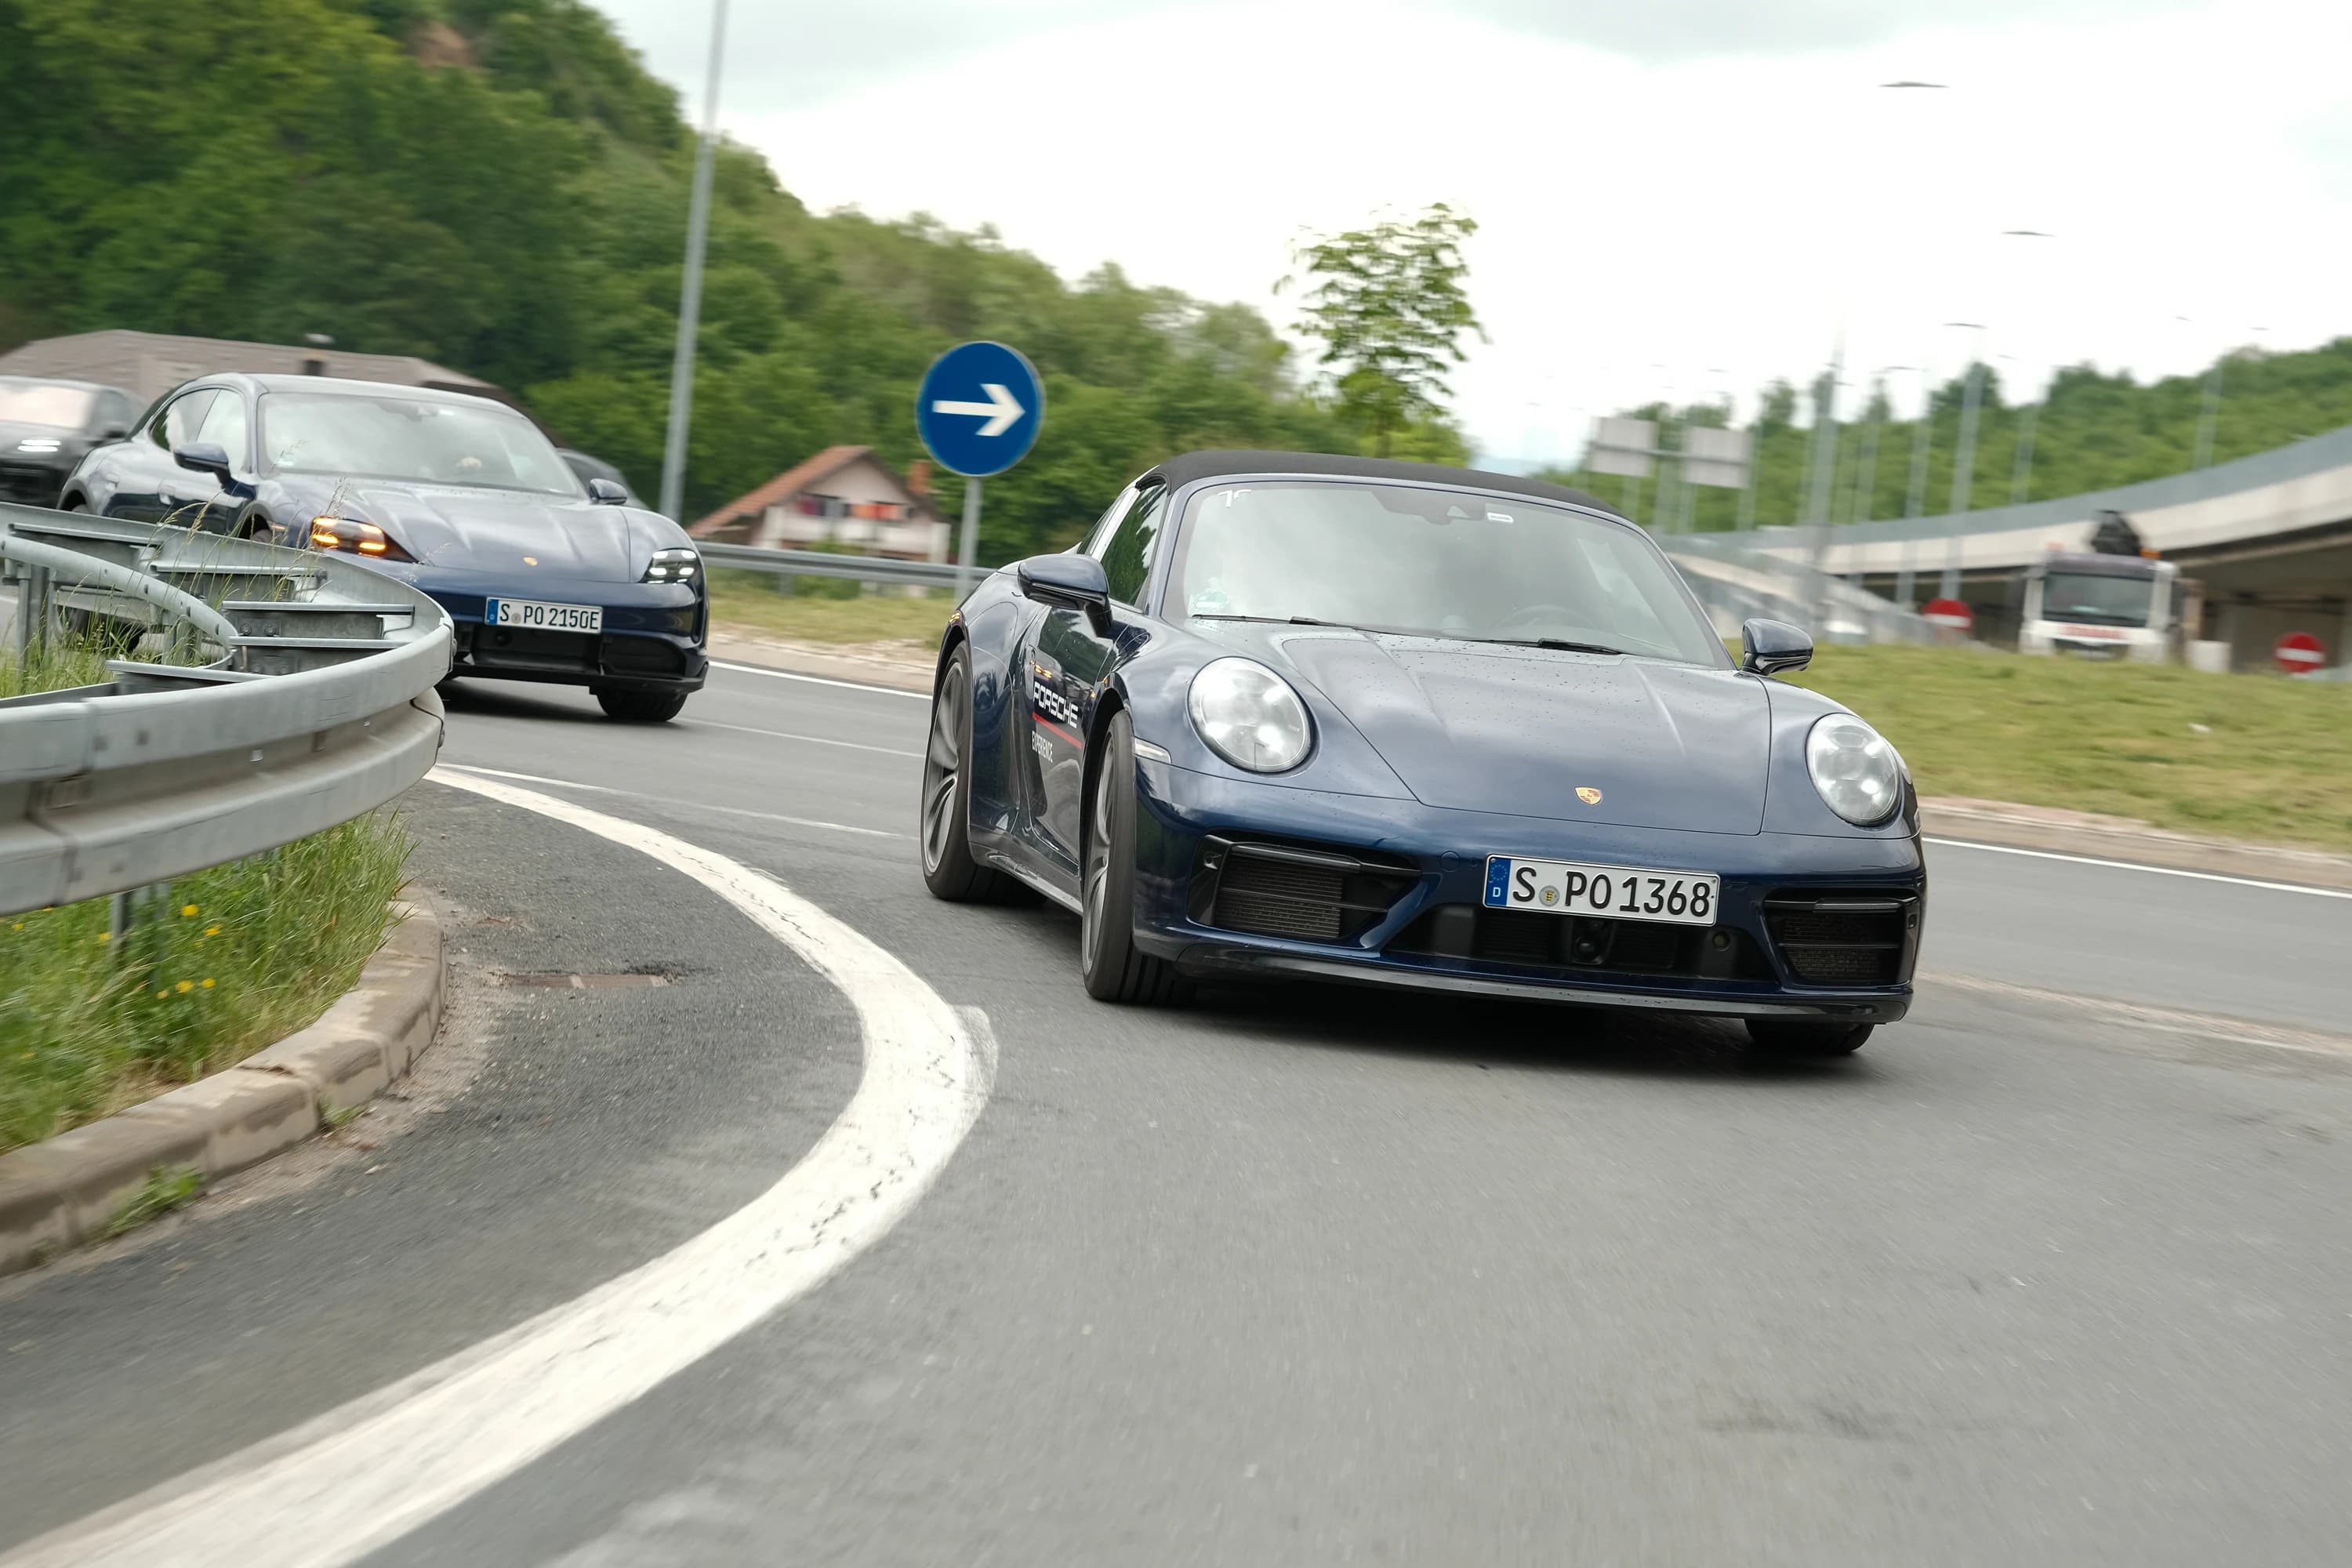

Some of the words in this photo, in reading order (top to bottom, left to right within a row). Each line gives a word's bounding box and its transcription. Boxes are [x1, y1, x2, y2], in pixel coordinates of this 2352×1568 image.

[499, 604, 510, 622] S
[524, 605, 544, 625] PO
[548, 608, 600, 630] 2150E
[1033, 681, 1079, 729] PORSCHE
[1492, 887, 1501, 898] D
[1512, 866, 1537, 902] S
[1564, 870, 1612, 909] PO
[1619, 876, 1711, 917] 1368
